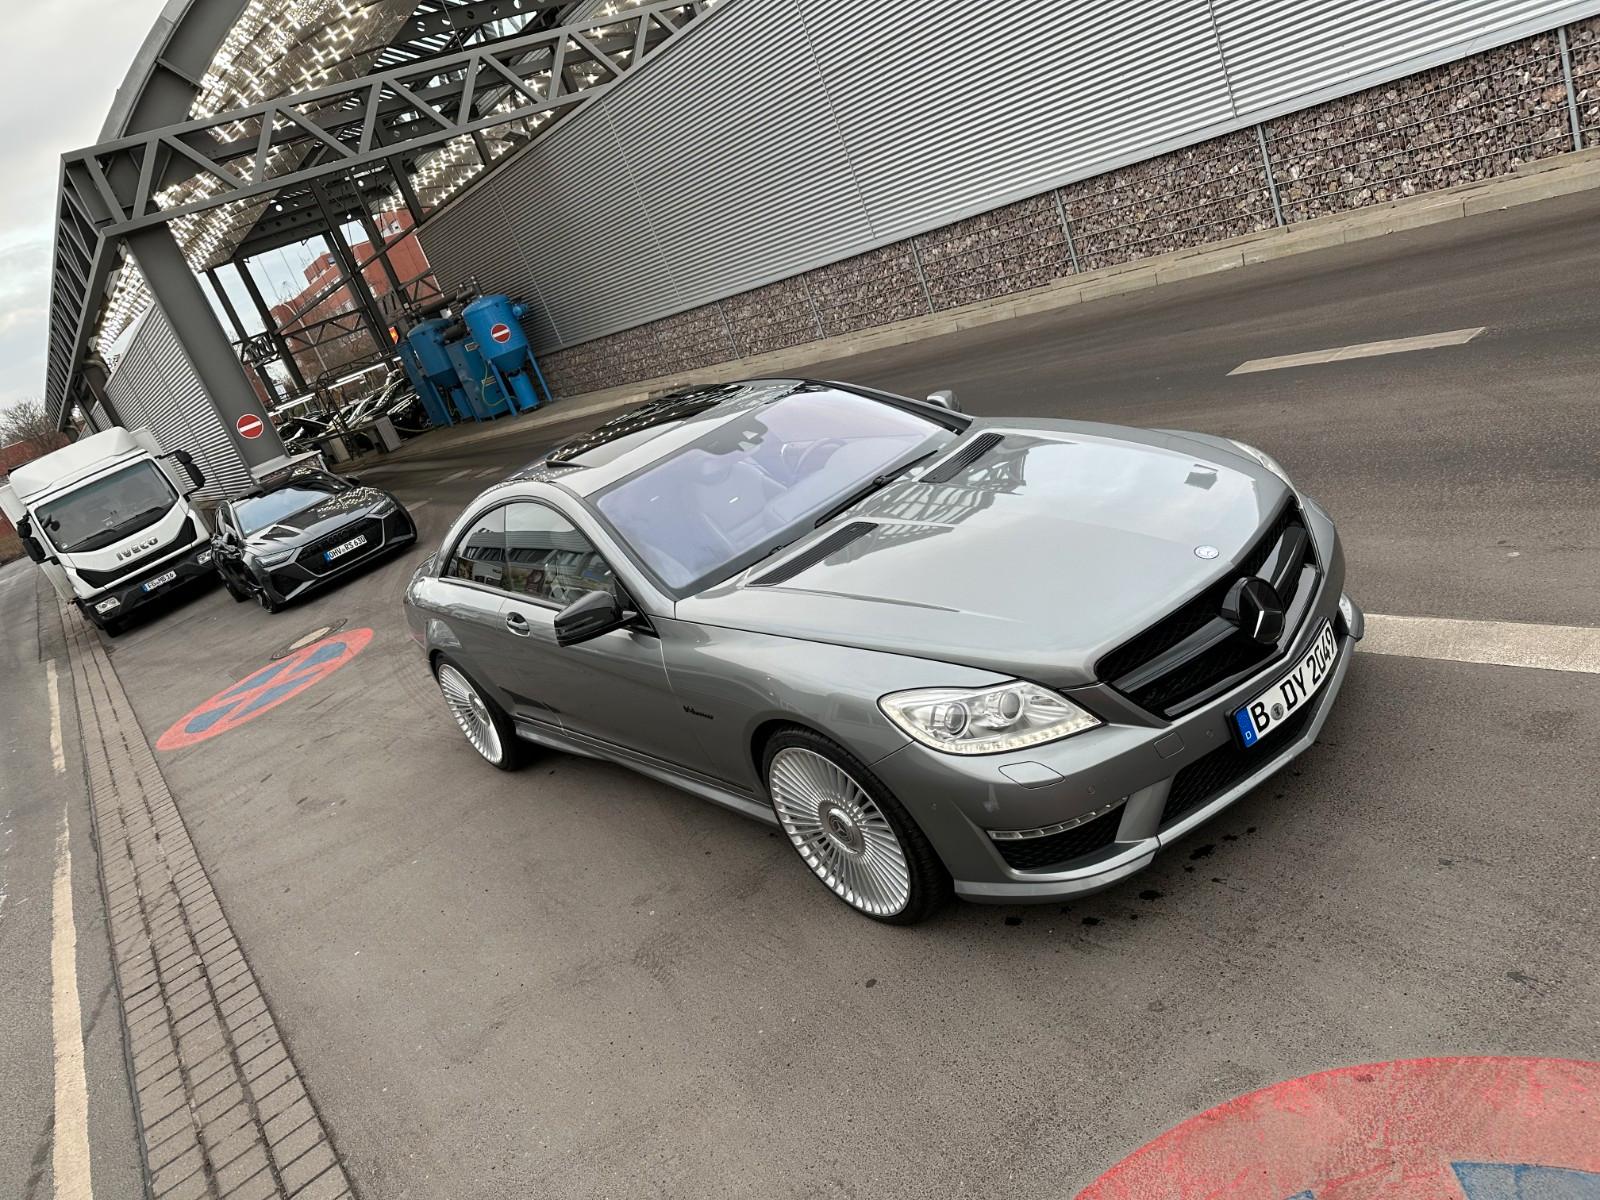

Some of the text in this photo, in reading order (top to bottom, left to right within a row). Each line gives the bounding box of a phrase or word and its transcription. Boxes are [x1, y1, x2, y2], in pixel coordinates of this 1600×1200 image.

[116, 537, 158, 561] IVECO
[328, 547, 342, 559] OHV
[344, 541, 354, 551] RS
[1250, 626, 1335, 733] B DY 2049
